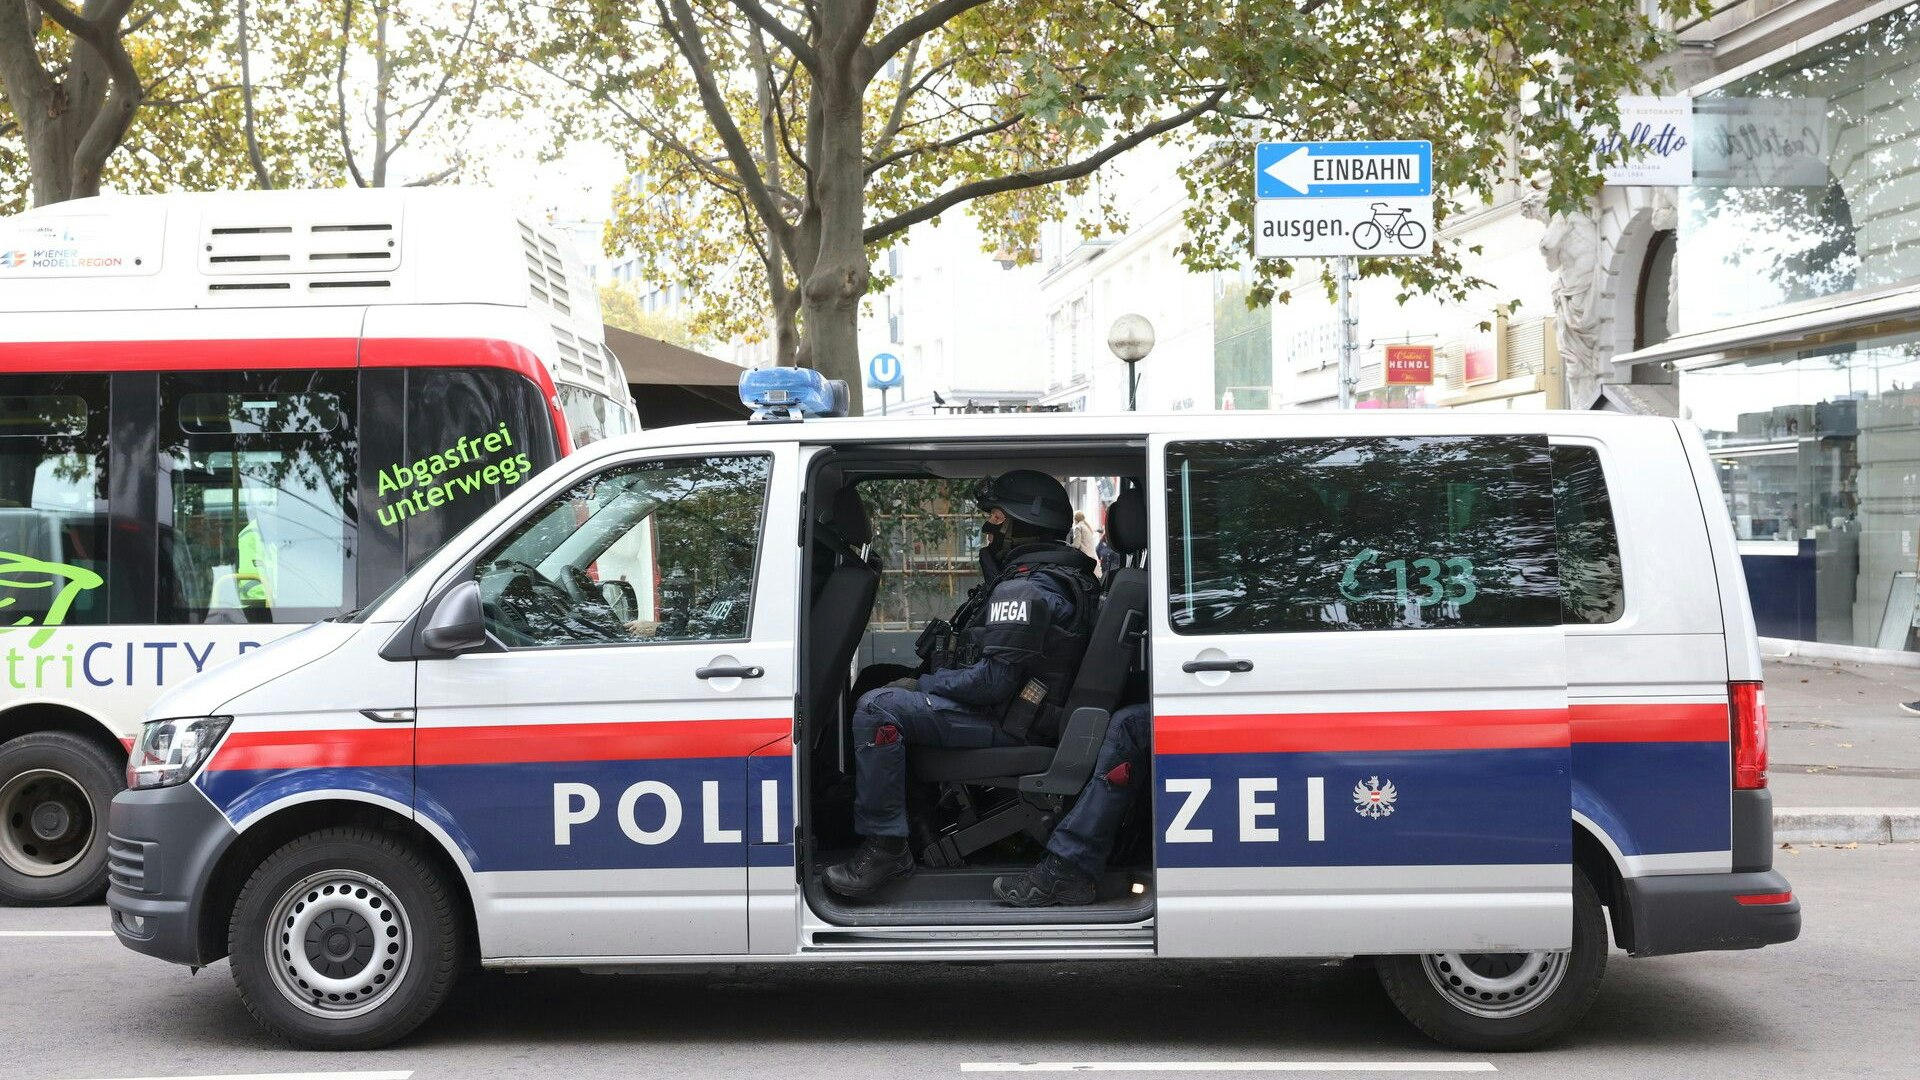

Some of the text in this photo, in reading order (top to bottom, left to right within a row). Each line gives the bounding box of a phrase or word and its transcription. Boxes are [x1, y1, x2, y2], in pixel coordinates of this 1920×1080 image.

[1314, 158, 1410, 181] EINBAHN
[1263, 218, 1350, 242] ausgen.
[32, 257, 122, 268] MODELLREGION
[874, 358, 896, 382] U
[1389, 360, 1430, 369] HEINDL
[378, 421, 513, 497] Abgasfrei
[377, 452, 532, 527] unterwegs
[1385, 558, 1478, 608] 133
[990, 600, 1028, 622] WEGA
